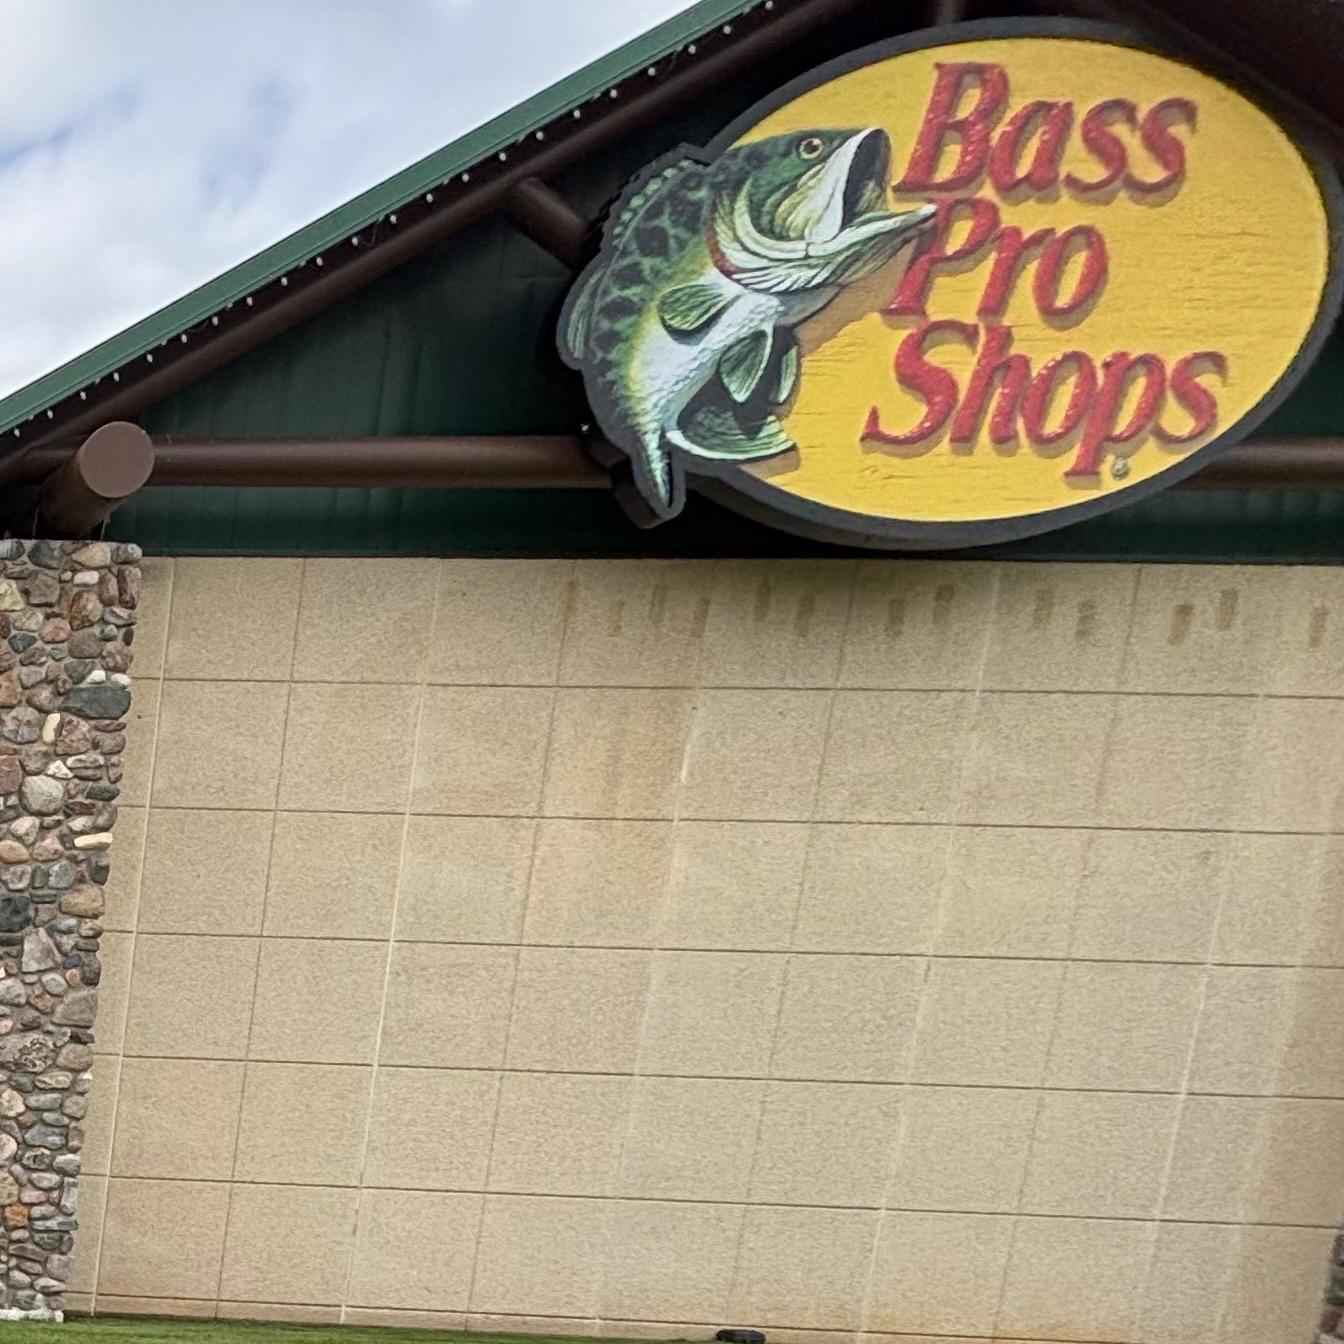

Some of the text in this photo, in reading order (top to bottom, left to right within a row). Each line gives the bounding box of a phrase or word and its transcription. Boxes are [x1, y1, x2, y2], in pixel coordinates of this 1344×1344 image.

[892, 61, 1199, 197] Bass
[881, 197, 1109, 320] Pro
[860, 320, 1229, 479] Shops
